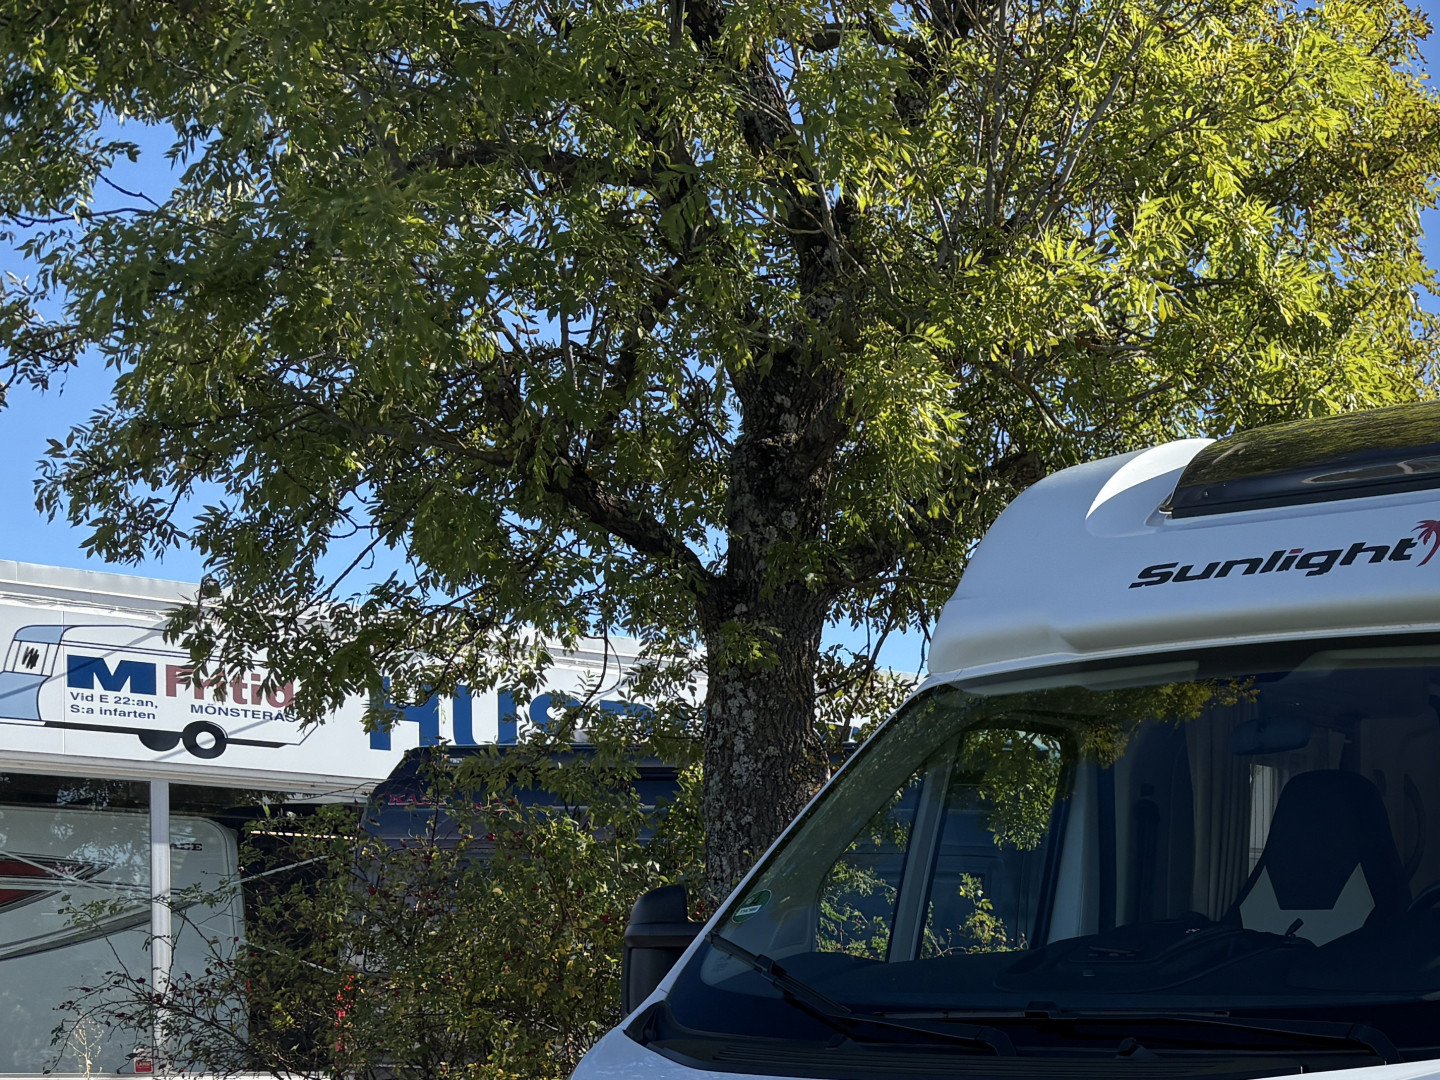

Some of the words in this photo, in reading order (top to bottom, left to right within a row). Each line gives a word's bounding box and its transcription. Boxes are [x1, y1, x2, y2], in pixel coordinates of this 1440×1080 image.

[1128, 537, 1418, 589] Sunlight
[66, 654, 157, 696] M
[70, 692, 94, 702] Vid
[99, 694, 110, 703] E
[113, 696, 158, 709] 22:an,
[70, 704, 94, 714] S:a
[99, 706, 156, 720] infarten
[190, 703, 297, 722] MÖNSTERÅS
